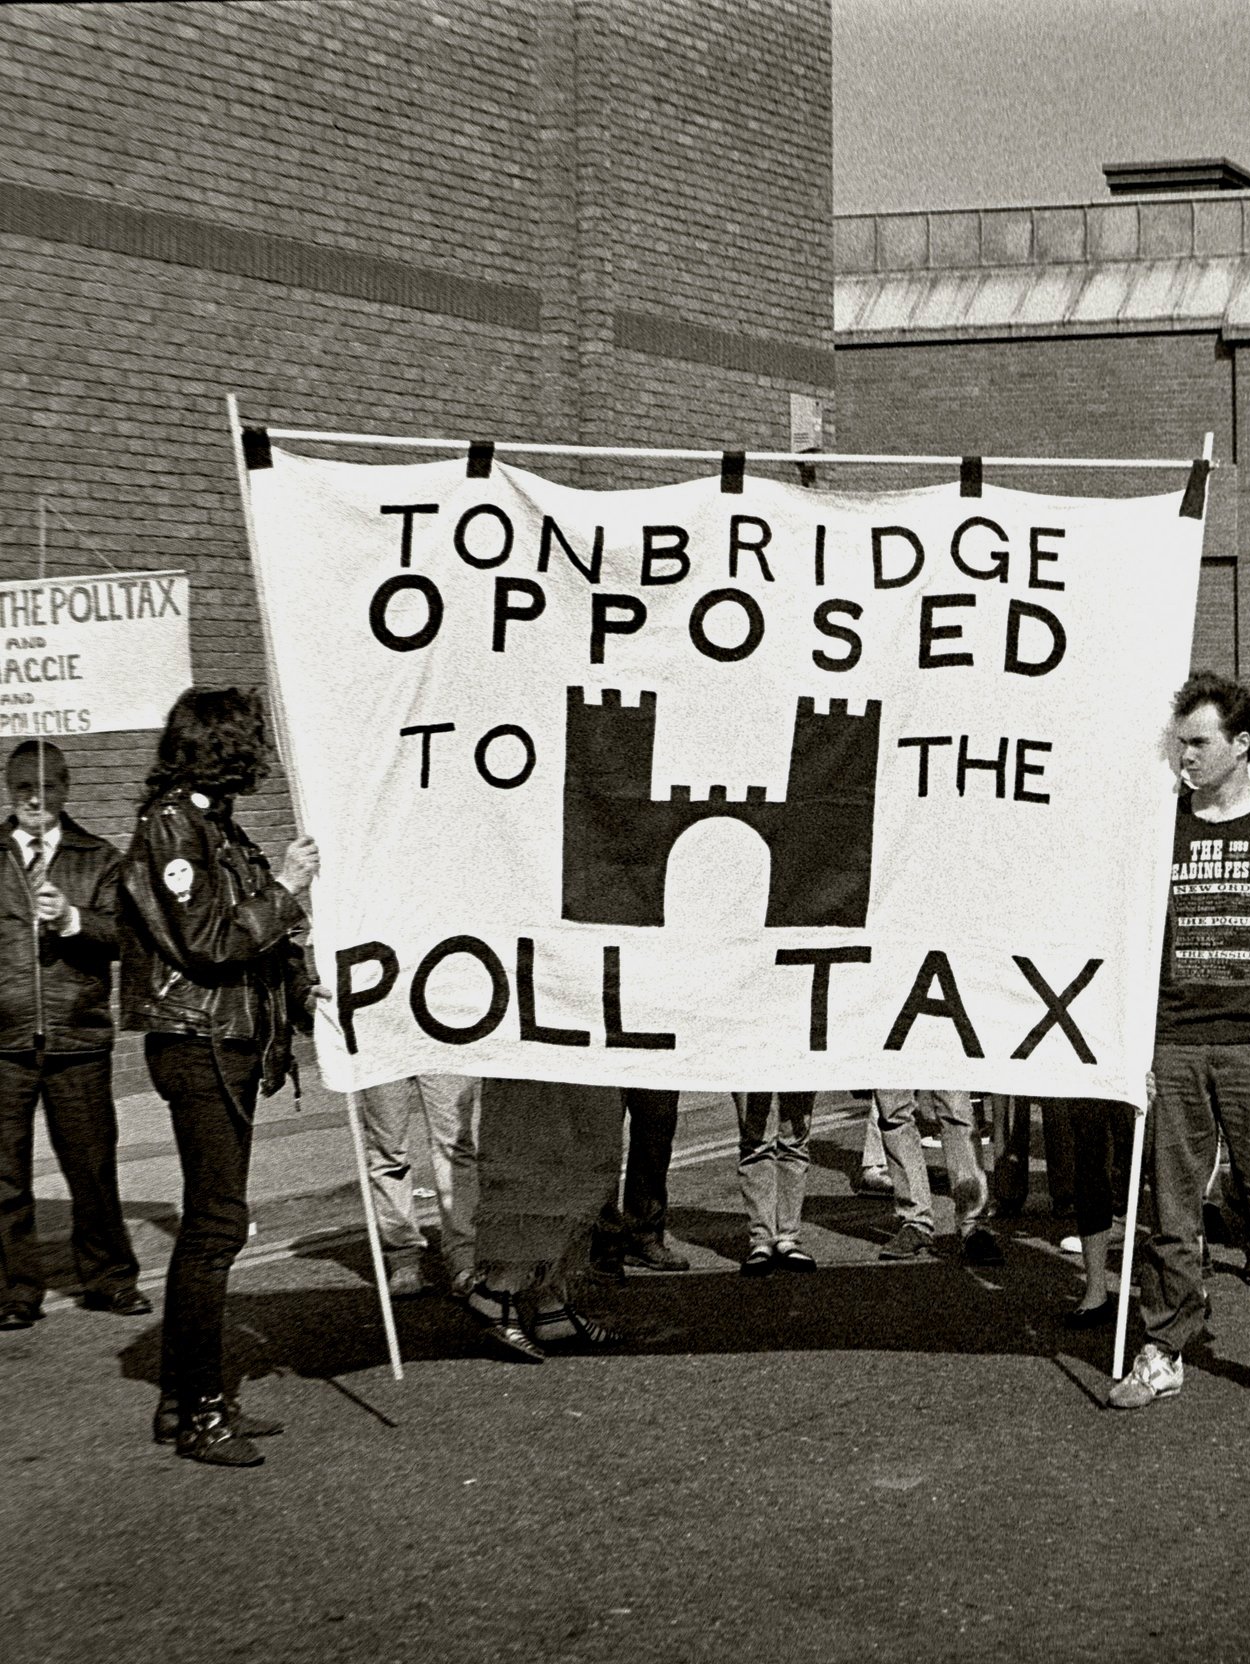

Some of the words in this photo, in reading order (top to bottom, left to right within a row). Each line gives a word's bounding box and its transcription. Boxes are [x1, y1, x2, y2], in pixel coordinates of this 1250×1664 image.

[380, 503, 1067, 591] TONBRIDGE
[369, 574, 1067, 677] OPPOSED
[5, 636, 47, 650] AND
[399, 722, 537, 790] TO
[897, 735, 1053, 805] THE
[1190, 839, 1223, 861] THE
[1172, 861, 1222, 881] EADING
[1176, 885, 1211, 893] NEW
[1181, 917, 1207, 926] THE
[1179, 951, 1205, 959] THE
[335, 934, 676, 1056] POLL
[775, 945, 1105, 1066] TAX
